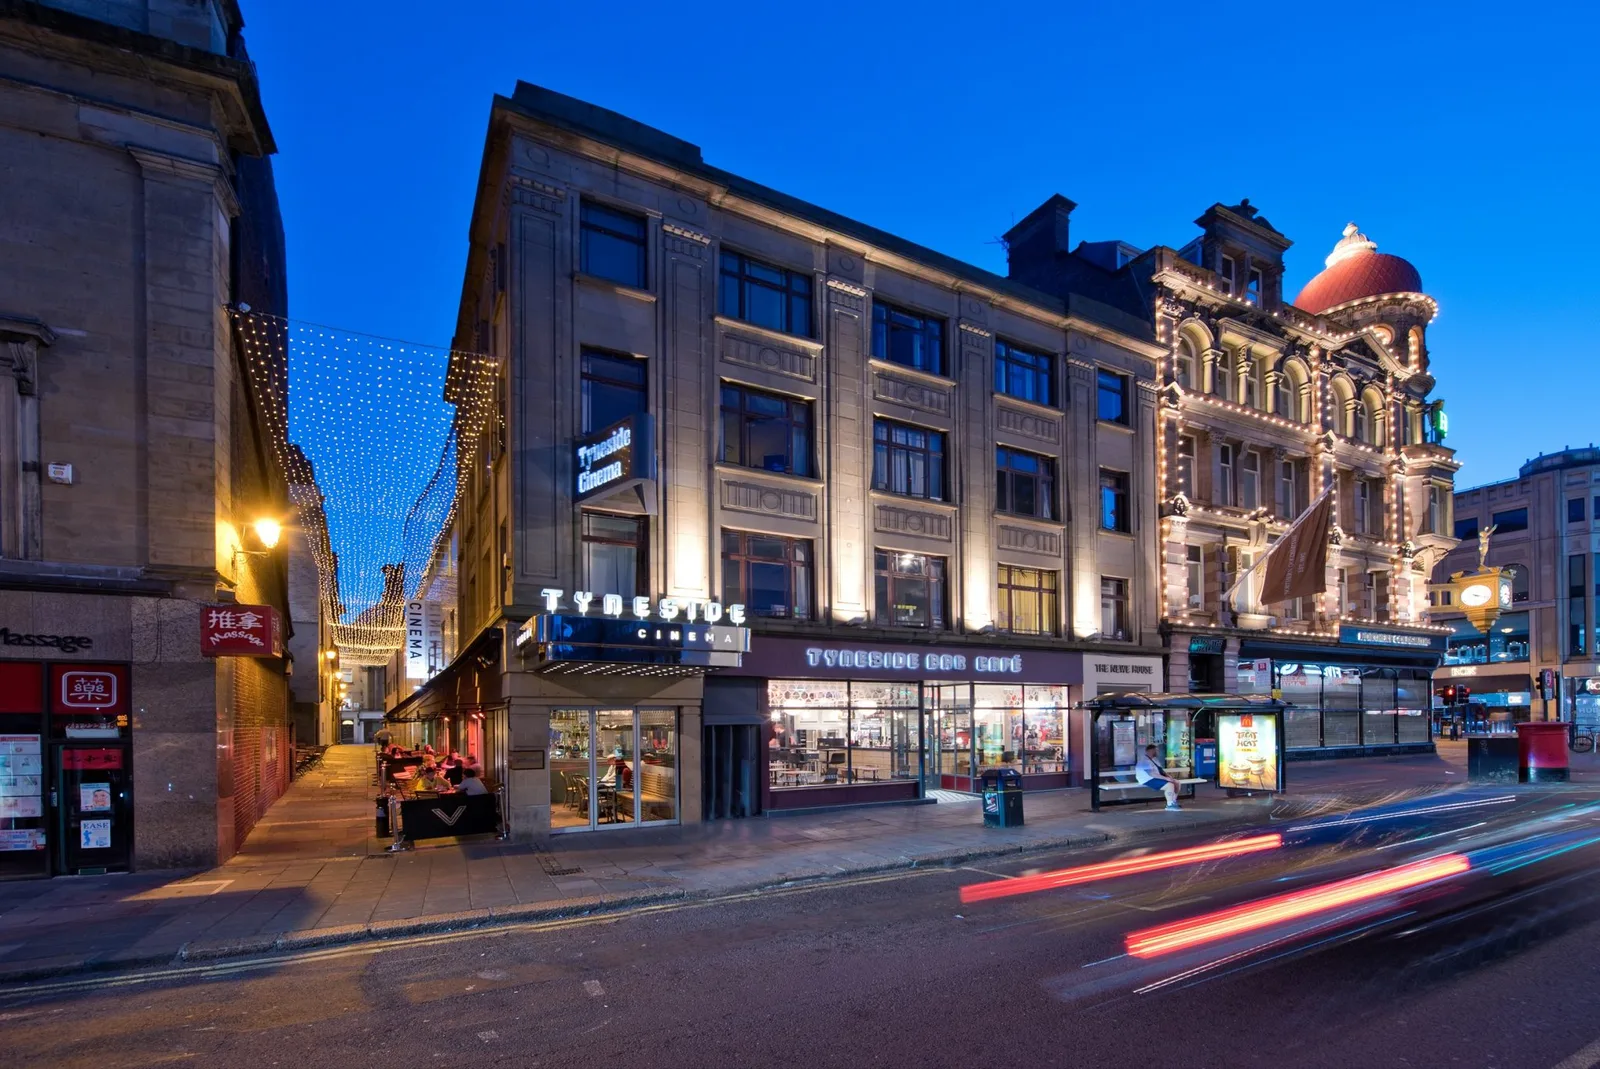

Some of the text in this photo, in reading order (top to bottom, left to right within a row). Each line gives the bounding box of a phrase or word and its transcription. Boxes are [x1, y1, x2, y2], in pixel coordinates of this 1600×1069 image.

[578, 427, 631, 470] Tyneside
[578, 461, 622, 493] Cinema
[541, 588, 746, 624] TYNESIDE
[208, 610, 263, 630] 推拿
[409, 602, 422, 659] CINEMA
[209, 631, 265, 646] Massage
[637, 629, 732, 643] CINEMA
[806, 647, 1023, 673] TYNESIDE BAR CAFÉ
[1095, 664, 1109, 673] THE
[1131, 665, 1154, 674] HOUSE
[69, 677, 110, 701] 藥
[83, 822, 109, 830] EASE
